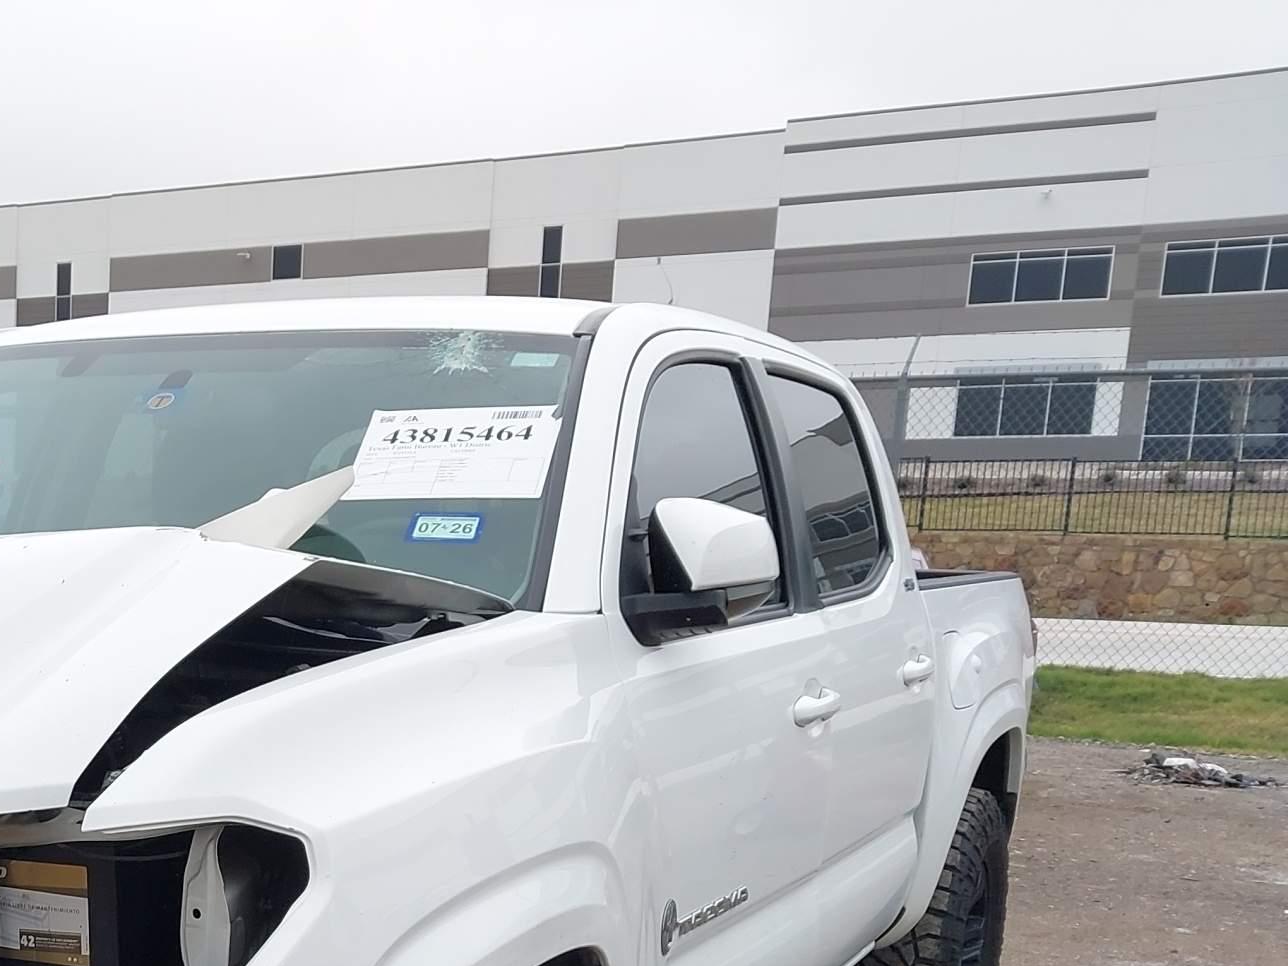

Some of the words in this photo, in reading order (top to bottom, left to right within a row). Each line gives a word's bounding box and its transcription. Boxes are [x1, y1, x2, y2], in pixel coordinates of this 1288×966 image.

[383, 424, 534, 444] 43815464
[417, 522, 442, 534] 07
[448, 522, 473, 534] 26
[20, 934, 36, 948] 42
